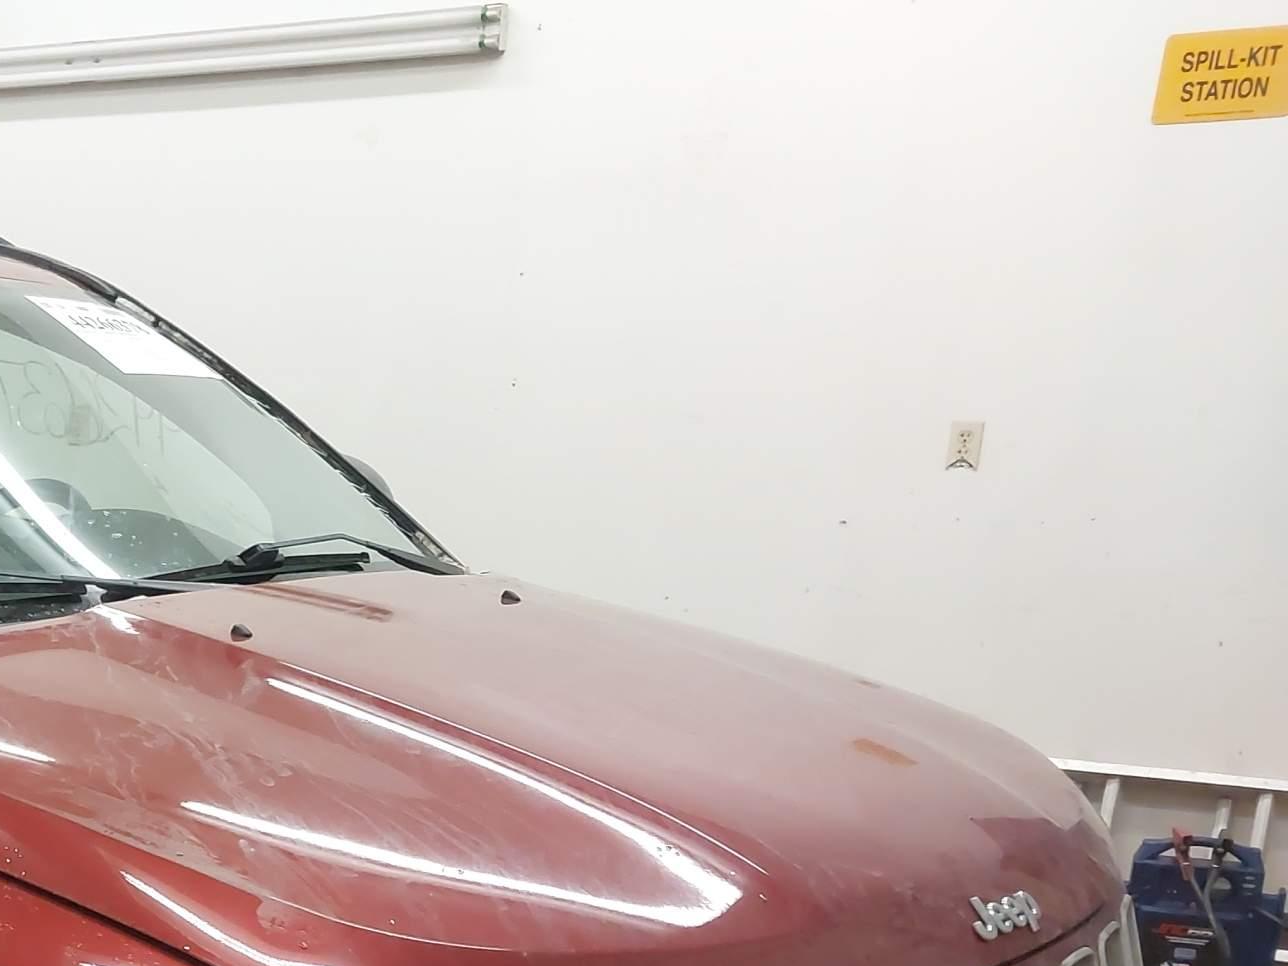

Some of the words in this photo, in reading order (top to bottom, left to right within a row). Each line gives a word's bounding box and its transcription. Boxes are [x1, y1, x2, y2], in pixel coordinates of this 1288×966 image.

[1180, 44, 1284, 73] SPILL-KIT
[1180, 76, 1270, 103] STATION
[969, 890, 1041, 940] Jeep
